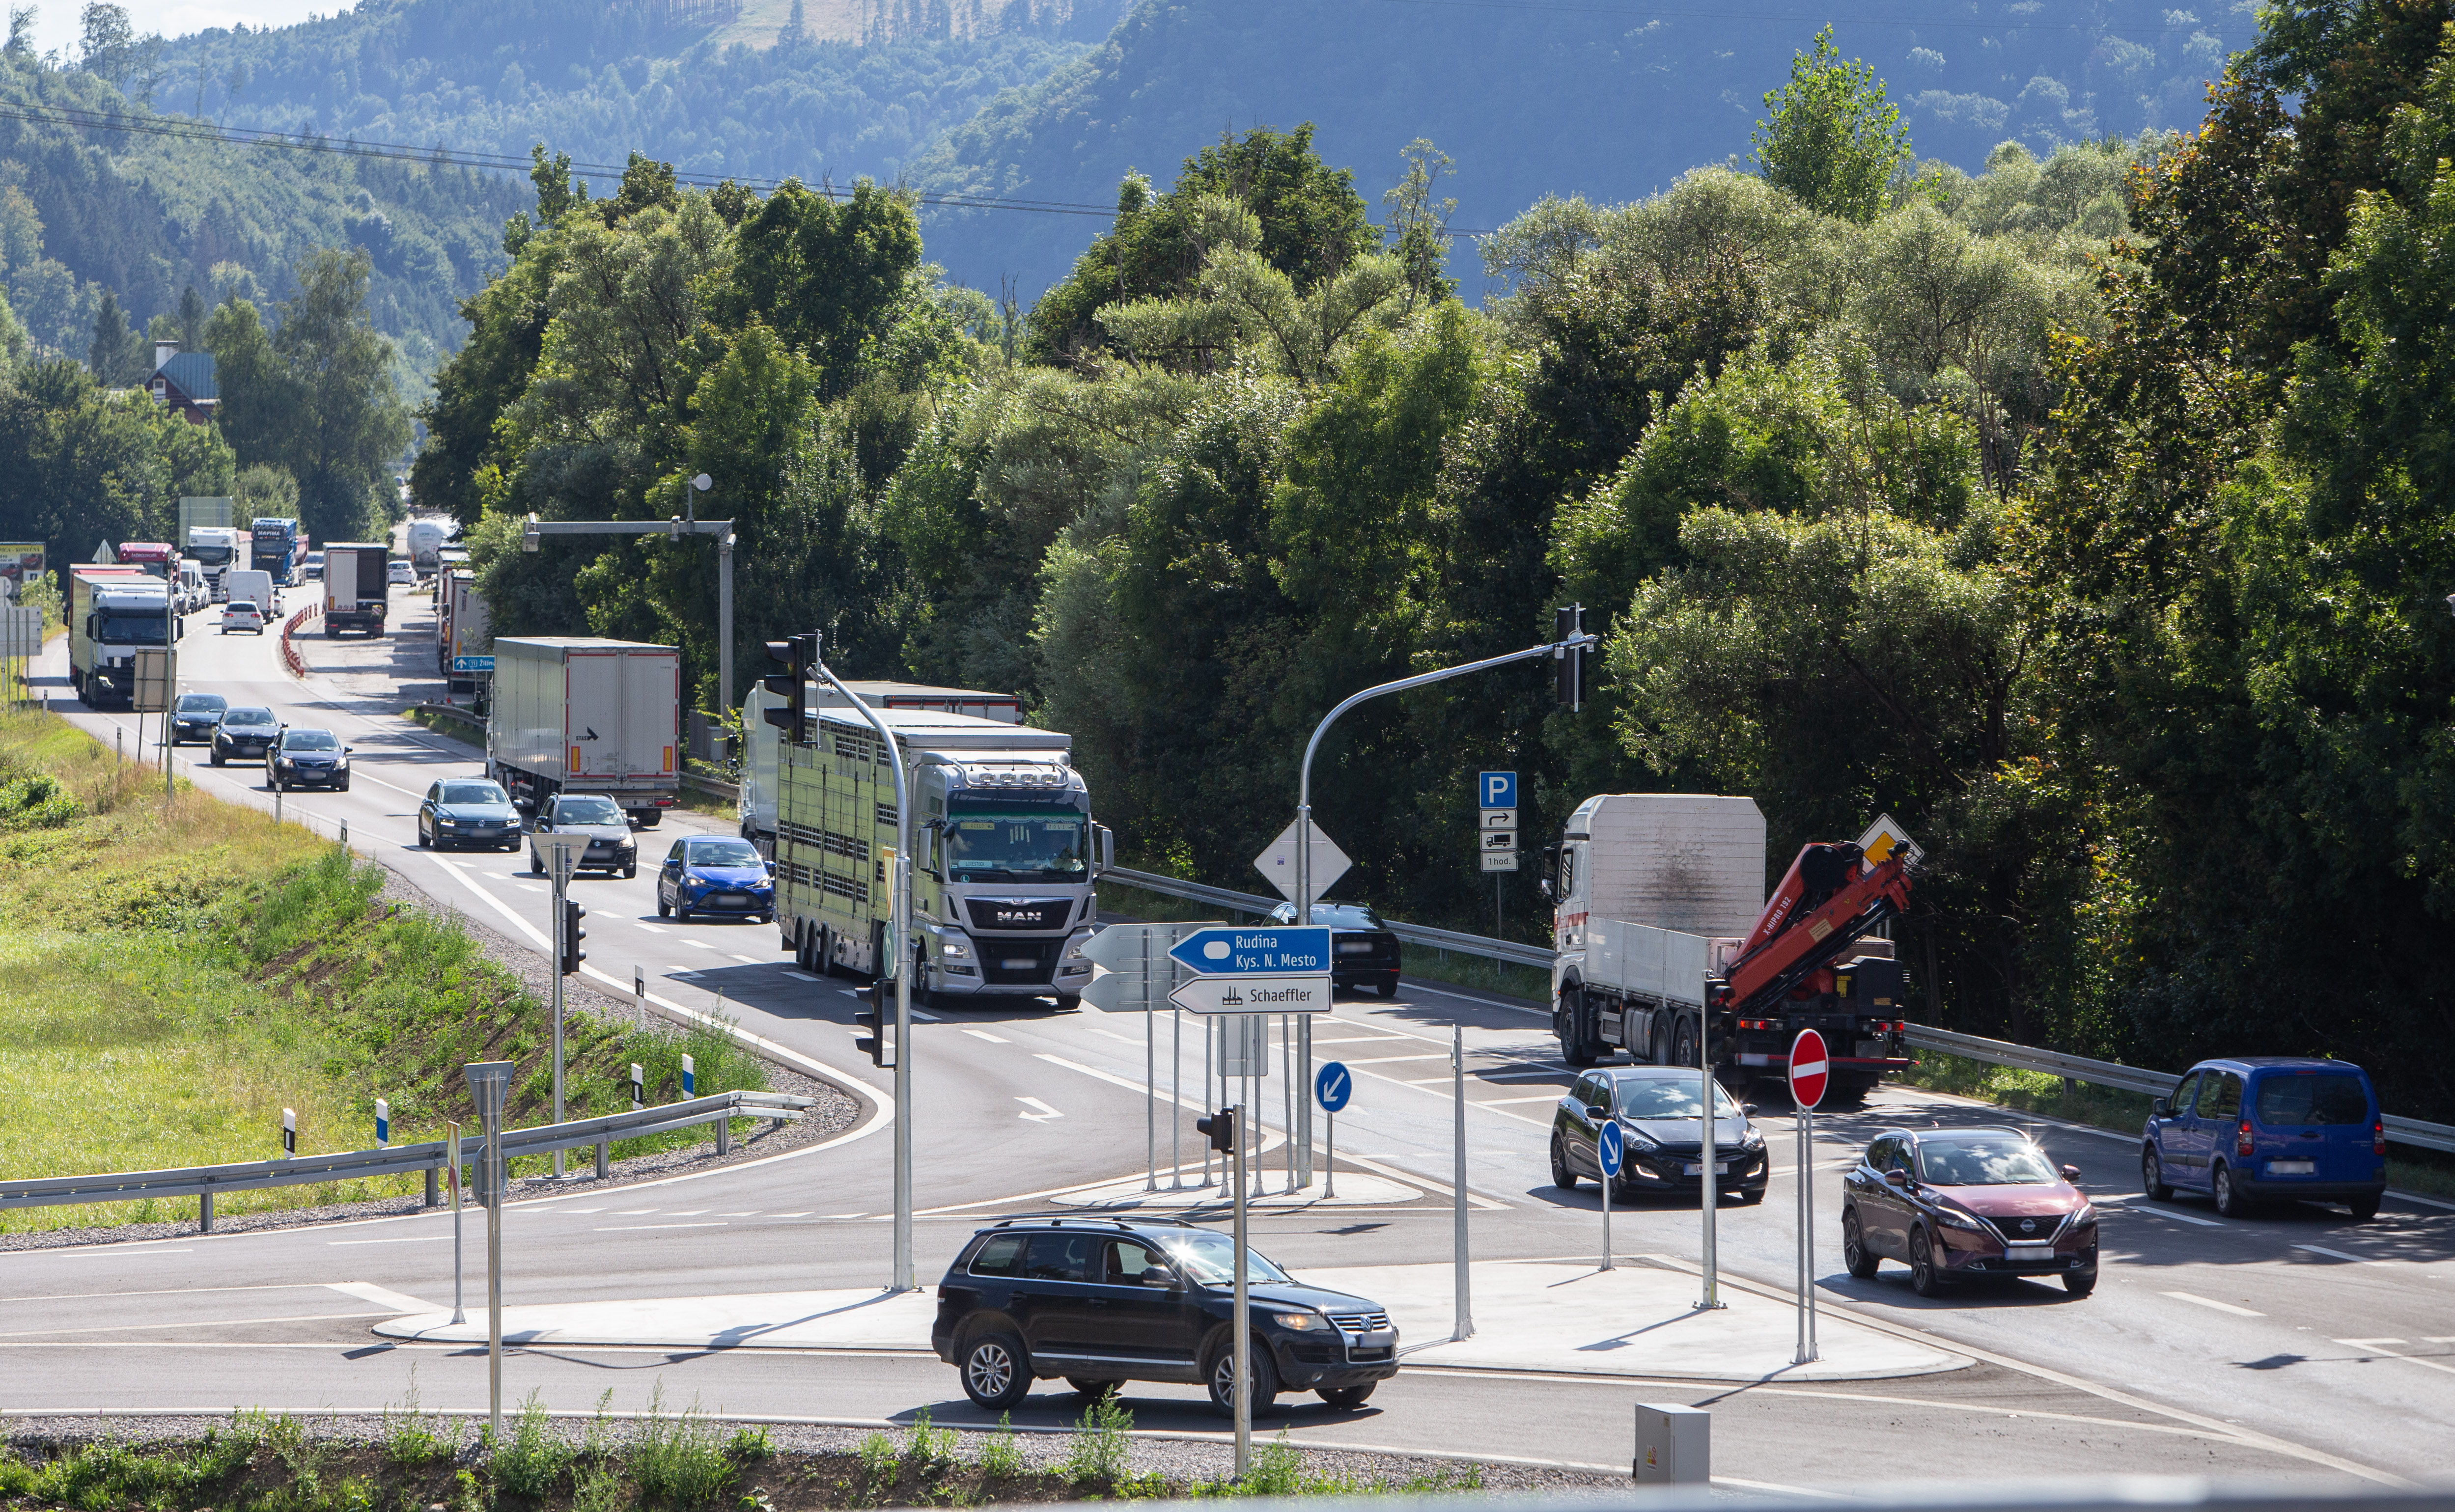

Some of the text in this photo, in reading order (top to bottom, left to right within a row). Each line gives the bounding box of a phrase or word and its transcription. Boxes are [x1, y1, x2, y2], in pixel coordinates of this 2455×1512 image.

[1489, 776, 1508, 803] P
[998, 911, 1041, 921] MAN
[1763, 909, 1784, 936] X-HIPRO
[1780, 896, 1792, 909] 192
[1236, 935, 1277, 949] Rudina
[1236, 953, 1316, 970] Kys. N. Mesto
[1250, 989, 1312, 1002] Schaeffler
